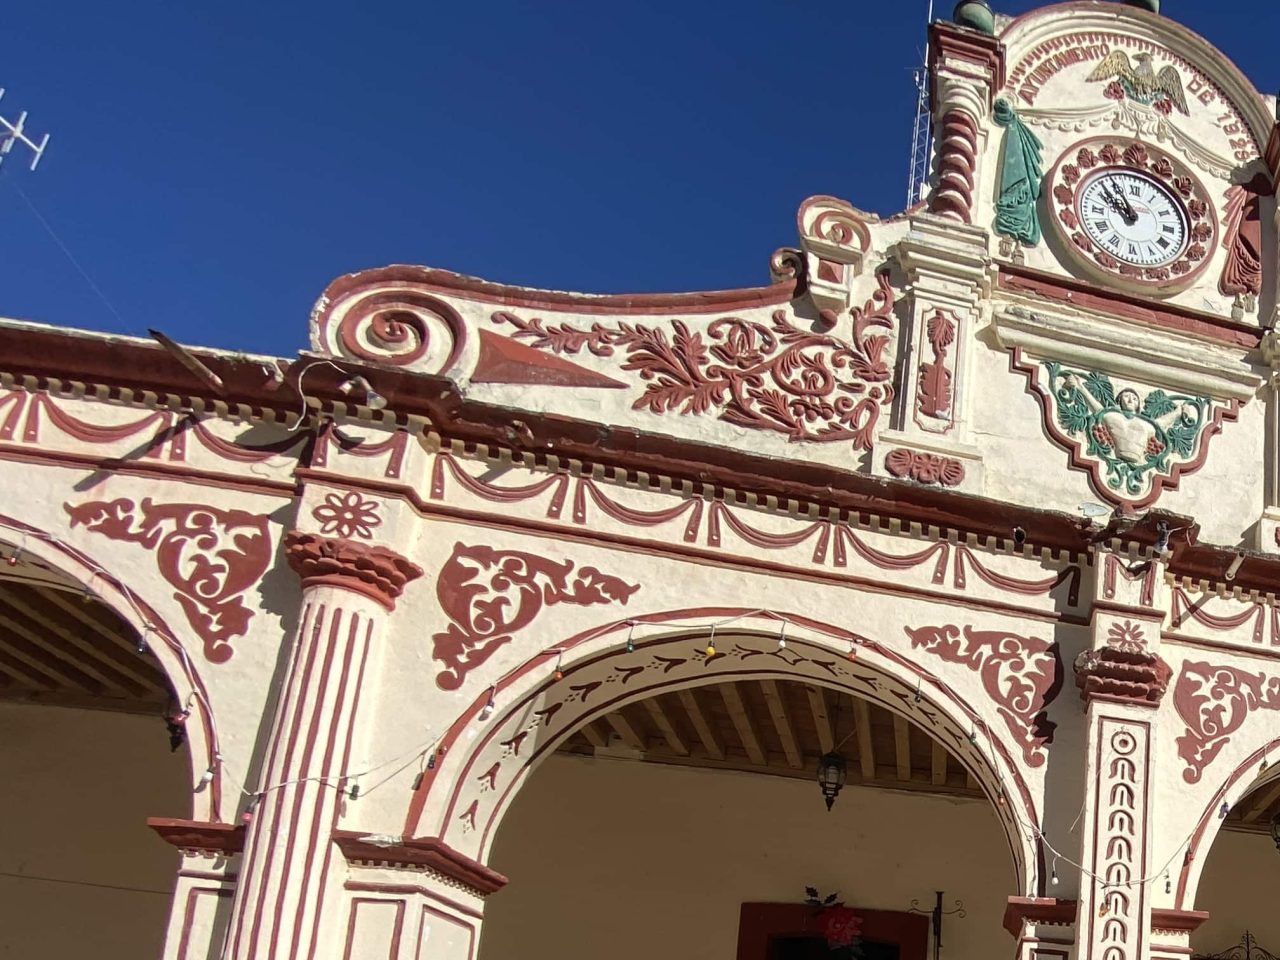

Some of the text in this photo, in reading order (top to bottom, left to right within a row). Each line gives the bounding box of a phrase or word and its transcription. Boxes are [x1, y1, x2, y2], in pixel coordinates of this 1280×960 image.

[1018, 43, 1110, 107] AYUNTAMIENTO
[1186, 79, 1215, 107] DE
[1129, 184, 1141, 197] XII
